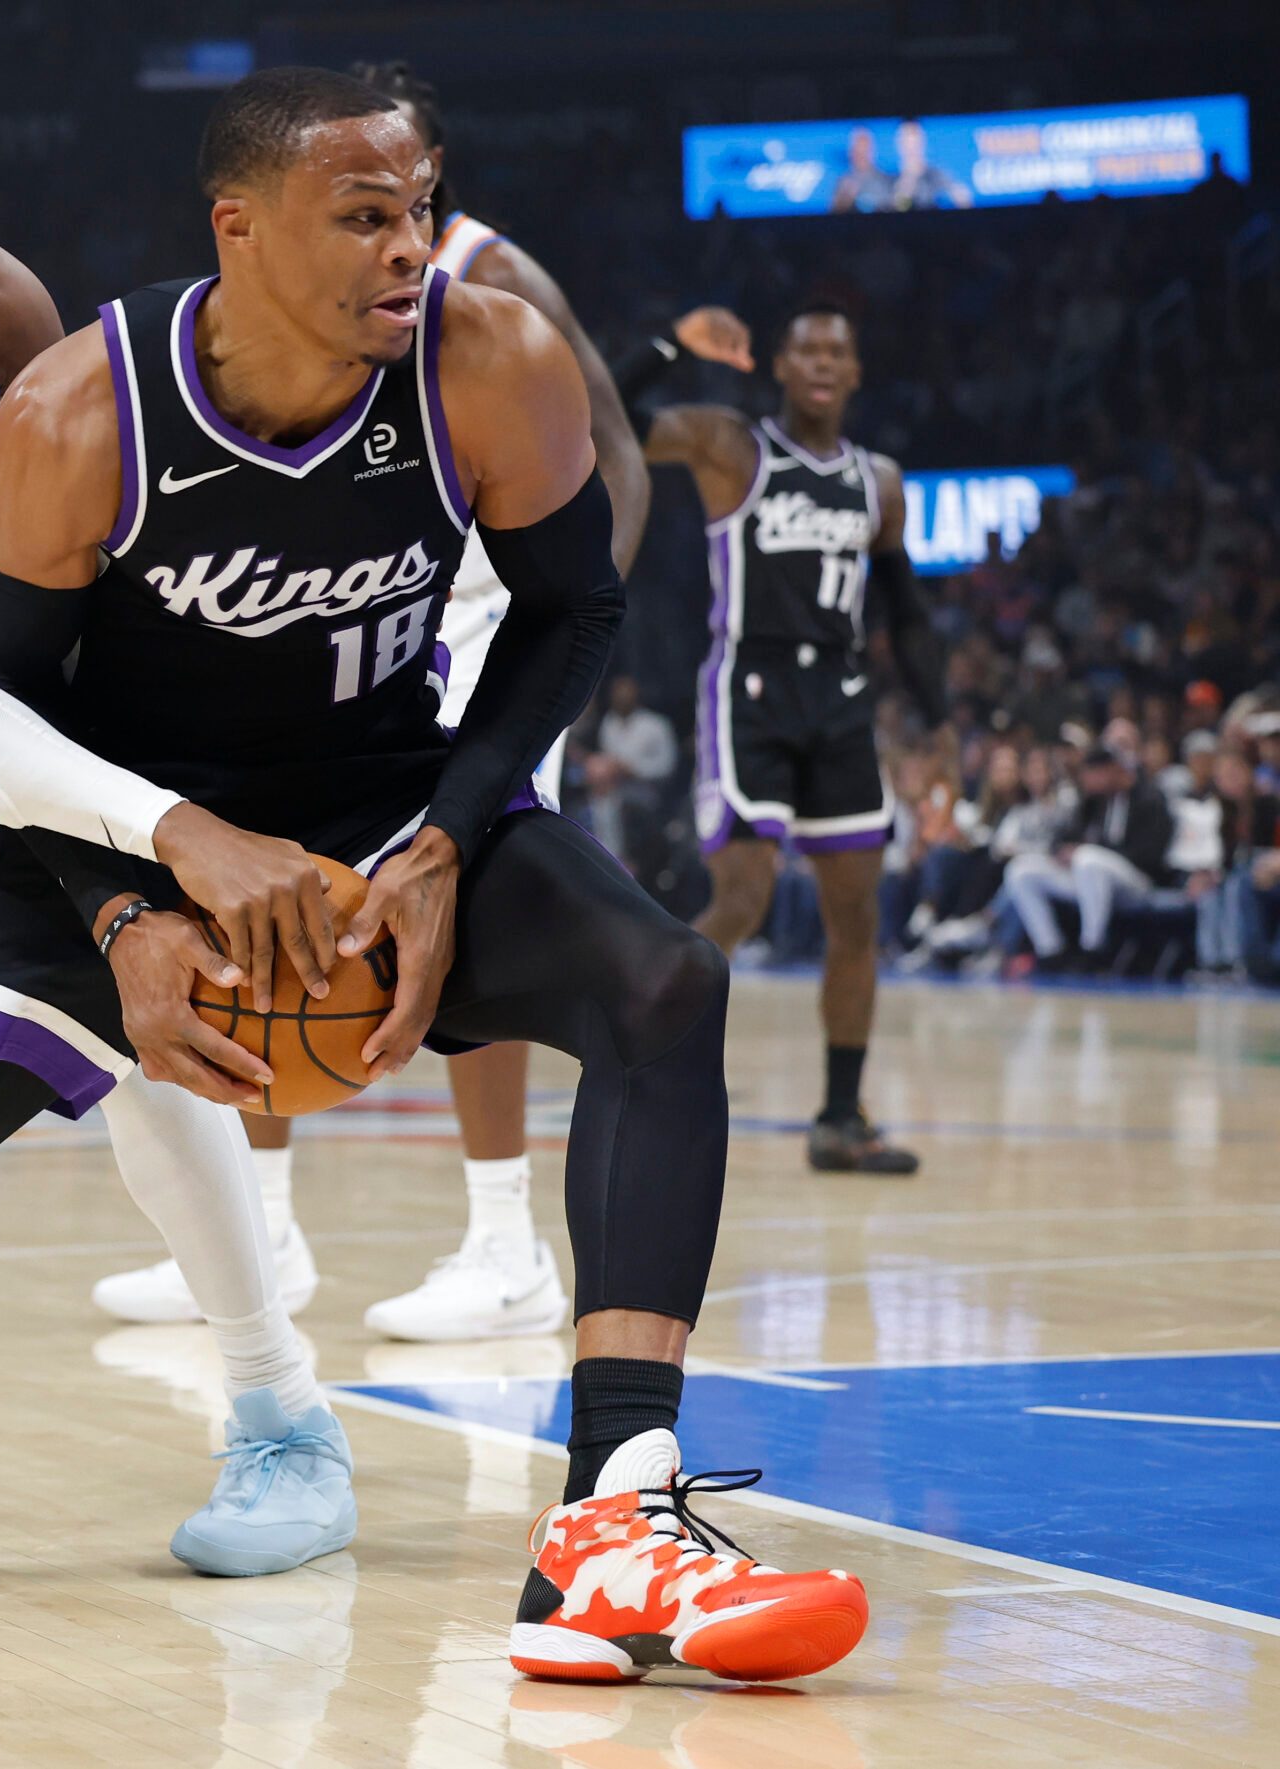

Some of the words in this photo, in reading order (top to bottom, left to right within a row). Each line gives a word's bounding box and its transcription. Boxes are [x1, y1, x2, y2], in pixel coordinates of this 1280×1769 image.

[354, 464, 396, 482] PHOONG
[397, 459, 420, 470] LAW
[755, 491, 869, 554] Kings
[144, 540, 440, 638] Kings
[329, 593, 434, 704] 18
